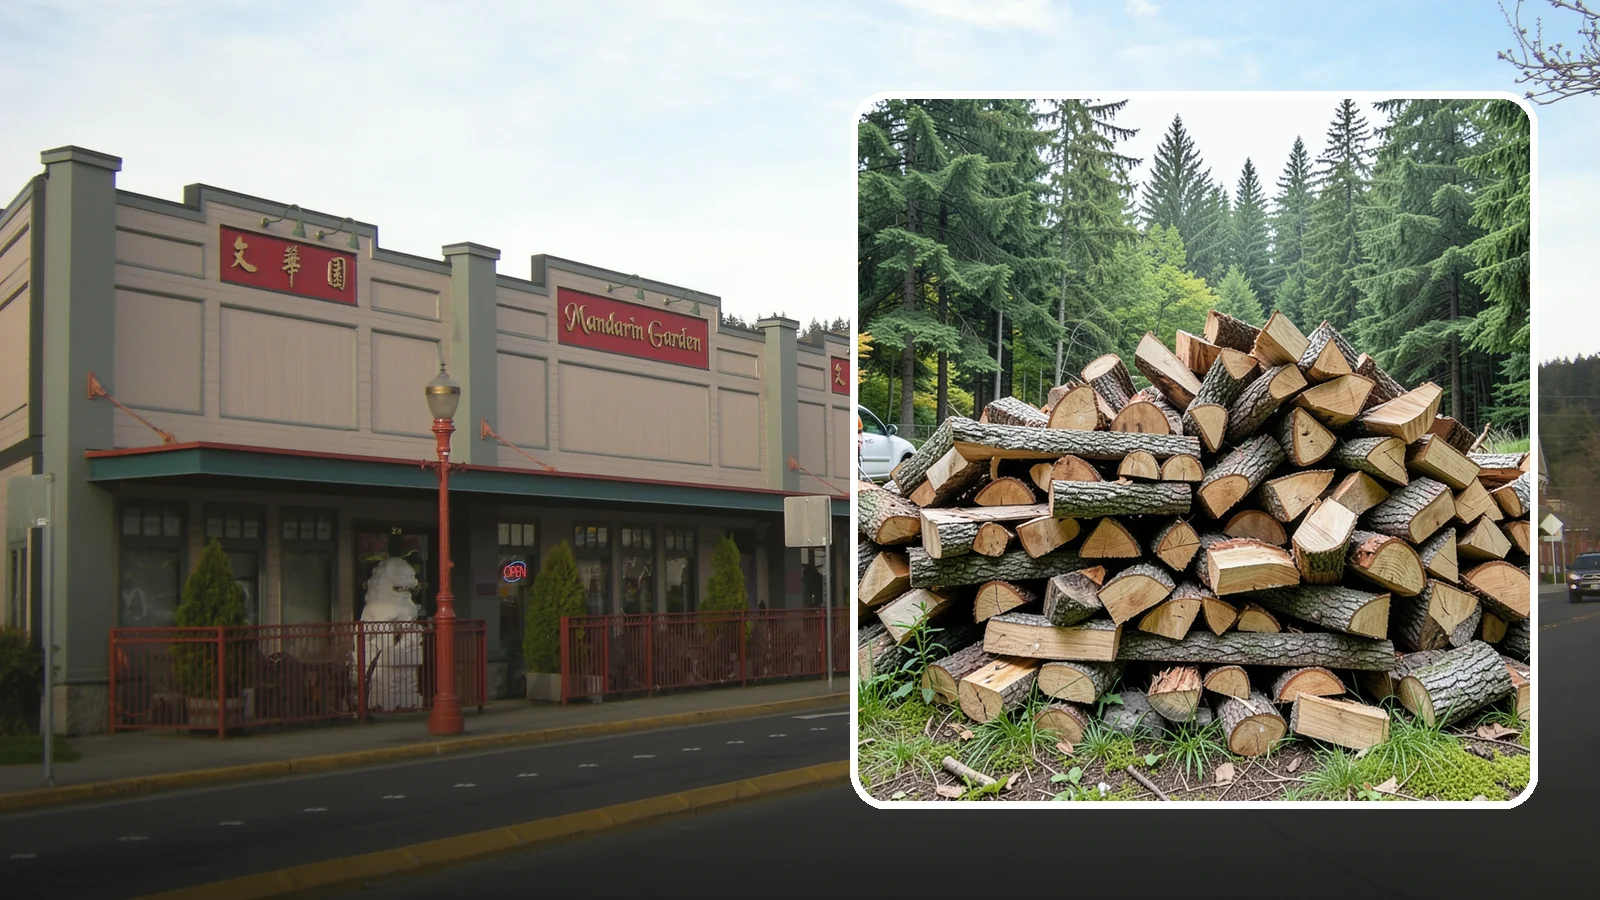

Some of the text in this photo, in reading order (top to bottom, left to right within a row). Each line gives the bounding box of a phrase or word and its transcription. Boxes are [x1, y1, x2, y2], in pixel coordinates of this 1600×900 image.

[230, 235, 346, 291] 文華園
[564, 302, 701, 352] Mandarin Garden
[503, 565, 527, 578] OPEN
